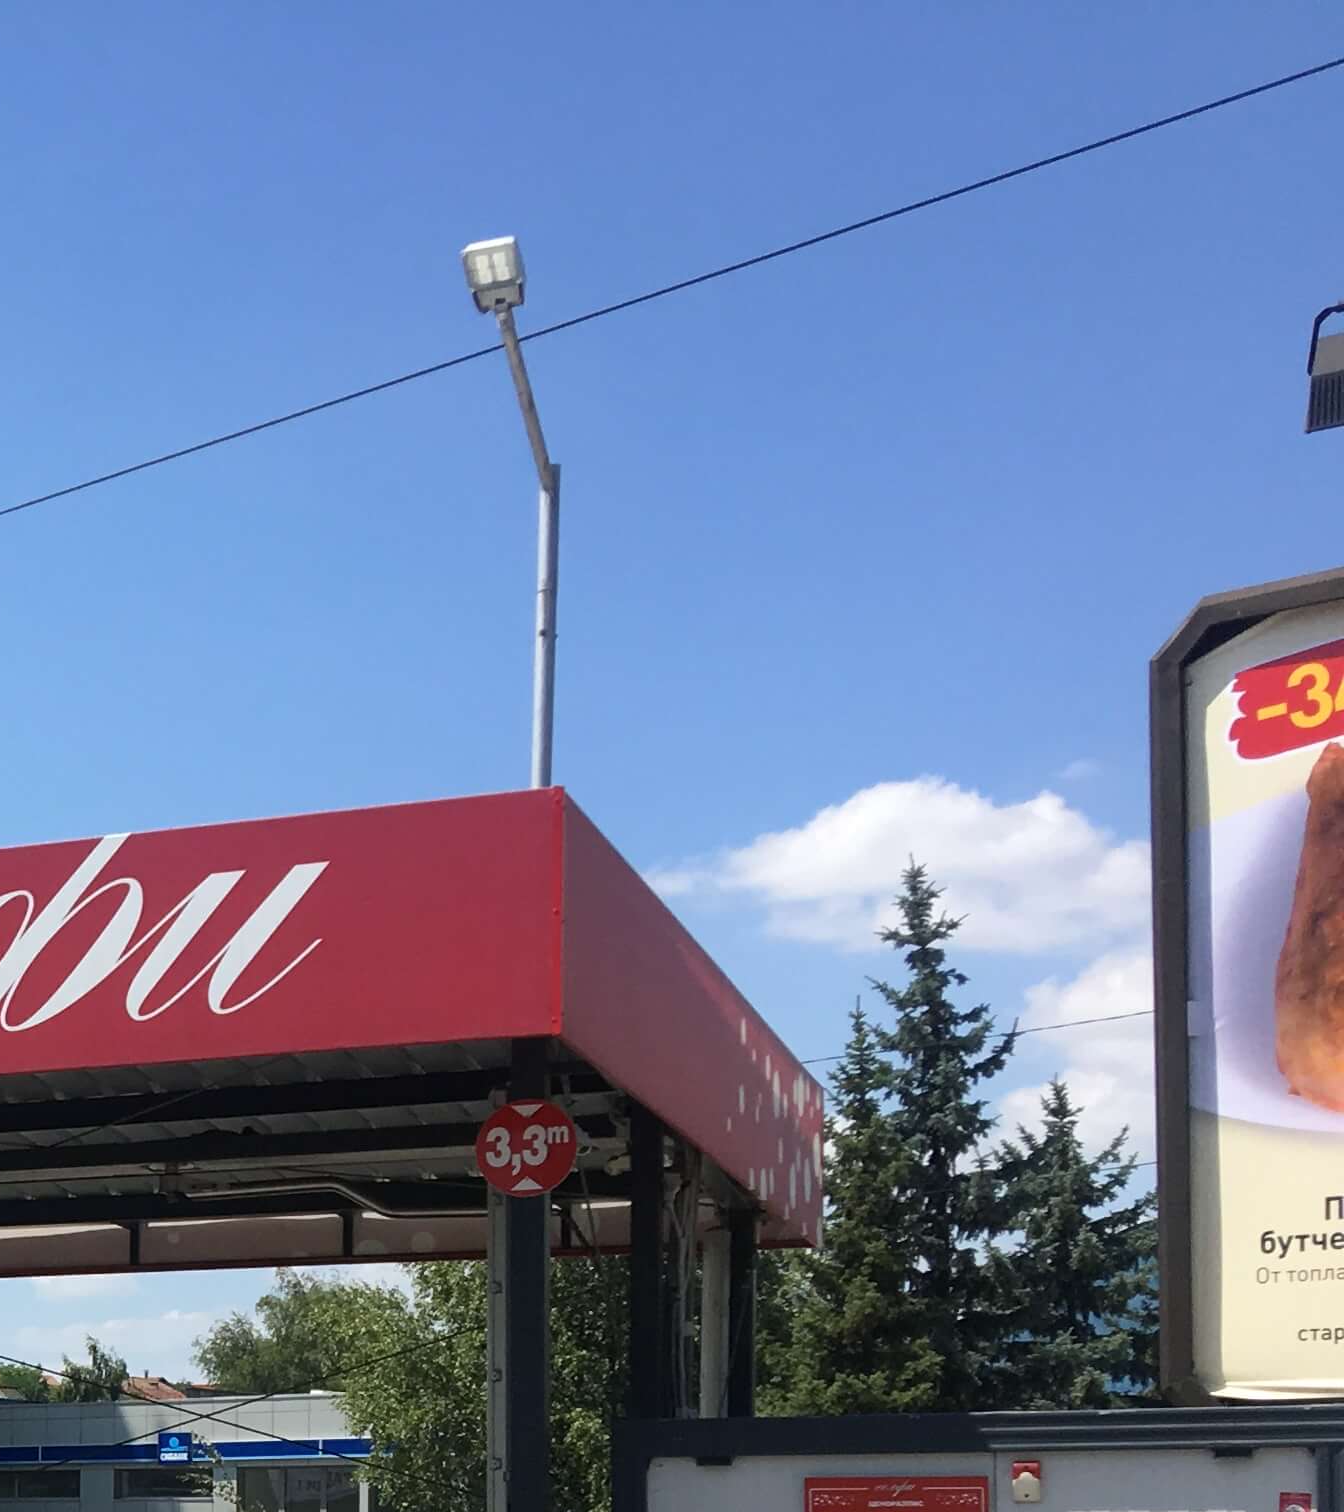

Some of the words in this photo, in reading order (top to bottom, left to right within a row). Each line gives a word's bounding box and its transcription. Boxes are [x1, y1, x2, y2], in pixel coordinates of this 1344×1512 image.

[1256, 663, 1344, 728] -3
[1260, 1230, 1344, 1259] бутче
[1256, 1266, 1281, 1285] От
